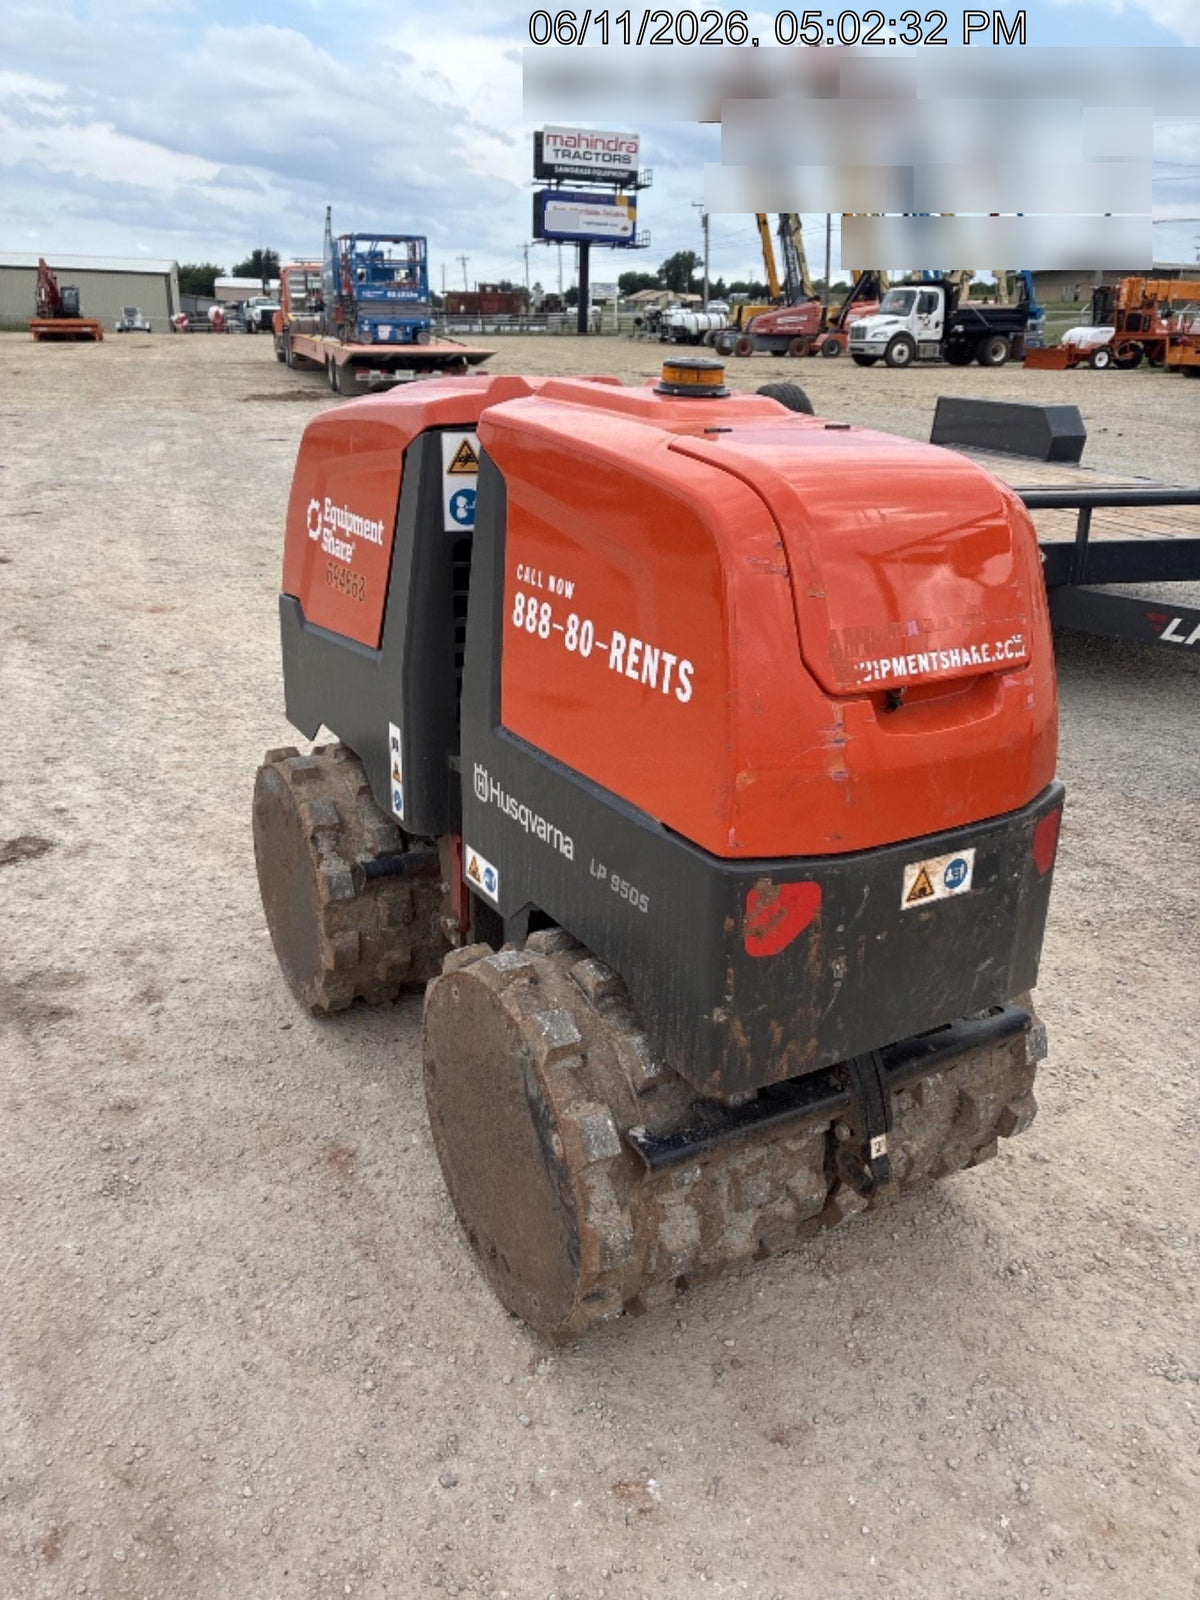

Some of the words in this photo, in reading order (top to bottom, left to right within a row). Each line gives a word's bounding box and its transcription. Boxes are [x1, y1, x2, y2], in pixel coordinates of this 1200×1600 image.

[545, 132, 638, 154] mahindra
[552, 148, 632, 165] TRACTORS
[324, 497, 384, 546] Equipment
[321, 527, 353, 564] Share
[516, 563, 543, 588] CALL
[548, 575, 575, 599] NOW
[513, 591, 694, 703] 888-80-RENTS
[489, 777, 573, 861] Husqvarna
[590, 858, 607, 880] LP
[610, 875, 650, 912] 9505
